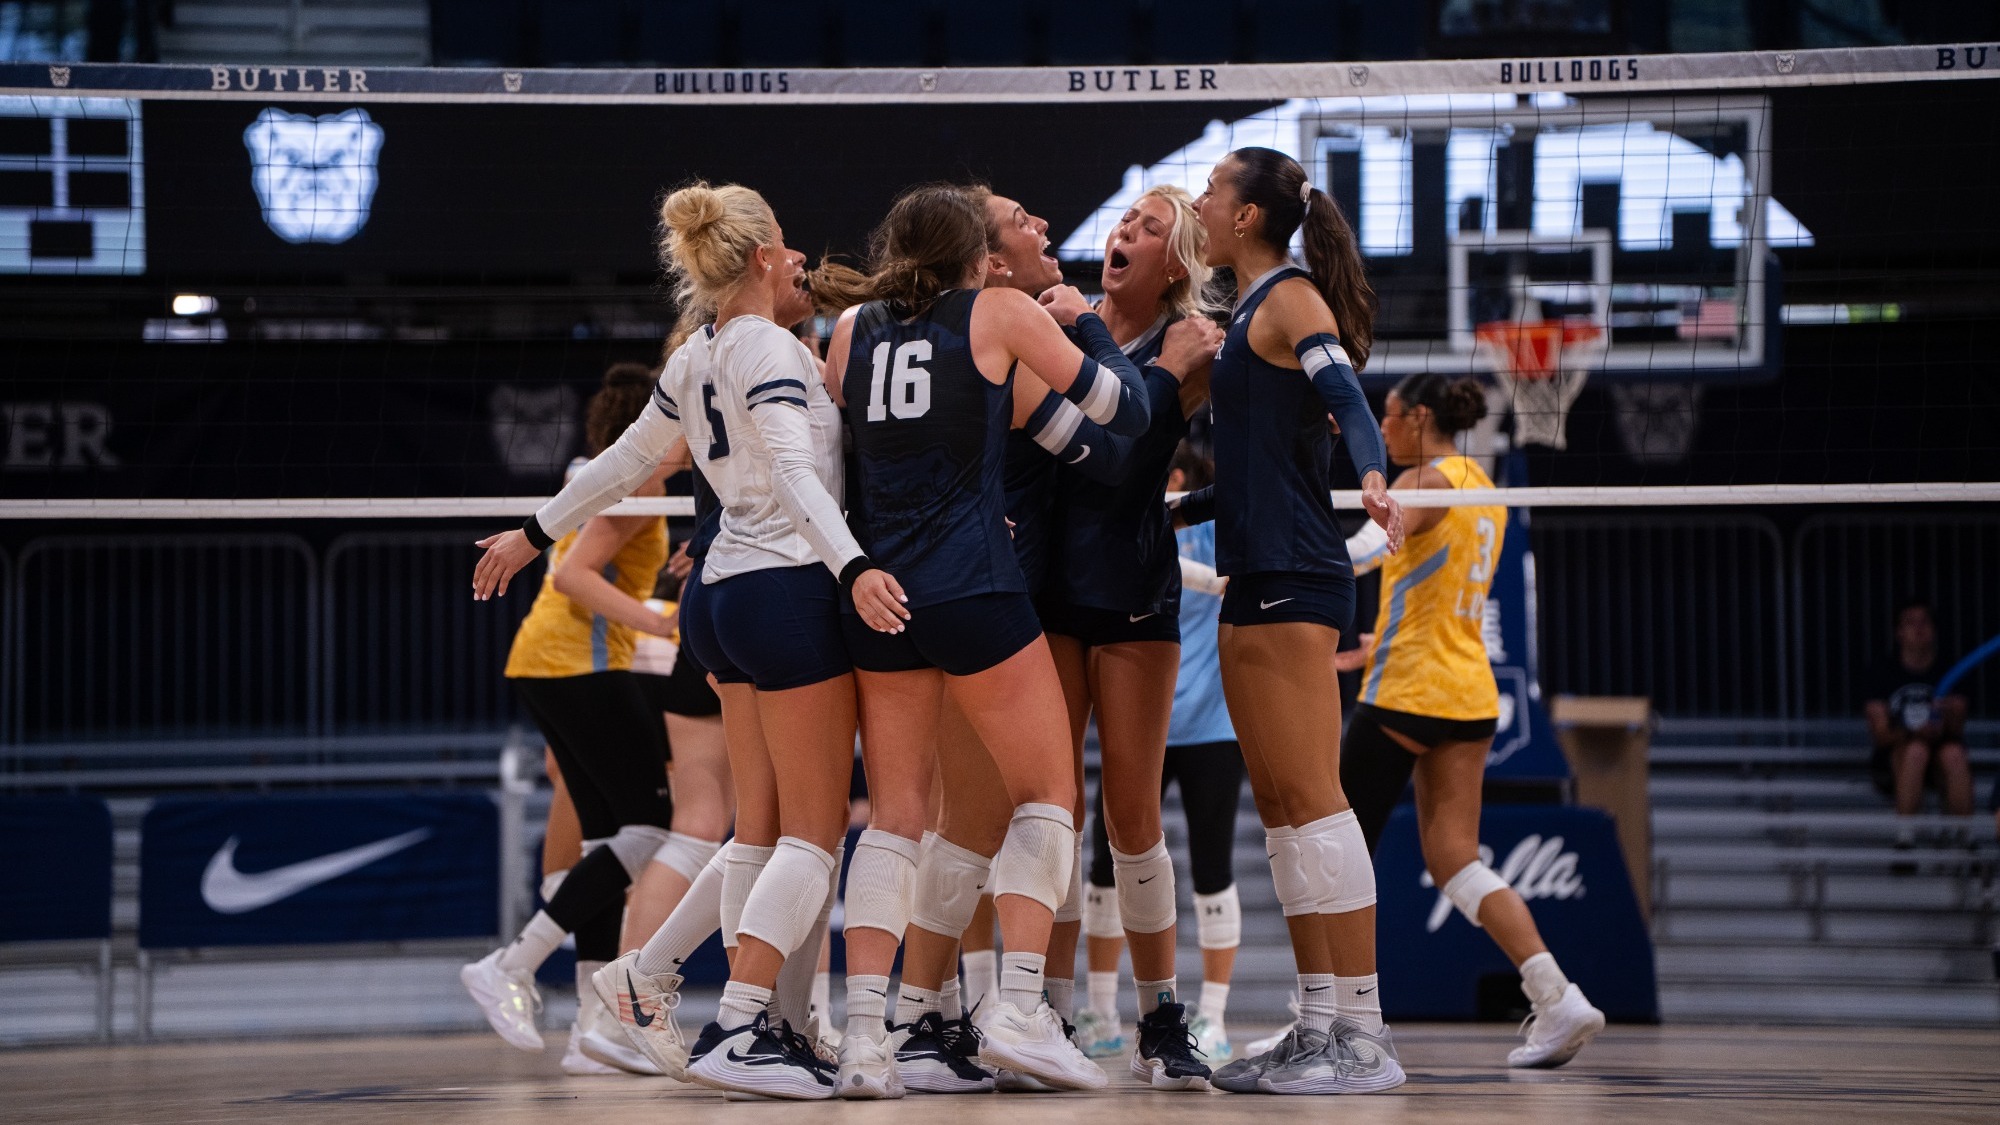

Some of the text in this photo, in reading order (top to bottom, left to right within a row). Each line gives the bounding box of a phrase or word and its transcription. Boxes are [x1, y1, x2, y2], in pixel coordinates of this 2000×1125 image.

[1936, 46, 2000, 70] BU
[210, 67, 370, 92] BUTLER
[655, 72, 789, 93] BULLDOGS
[1068, 69, 1218, 92] BUTLER
[1501, 59, 1638, 83] BULLDOGS
[867, 339, 933, 422] 16
[702, 383, 730, 461] 5
[1468, 516, 1496, 583] 3
